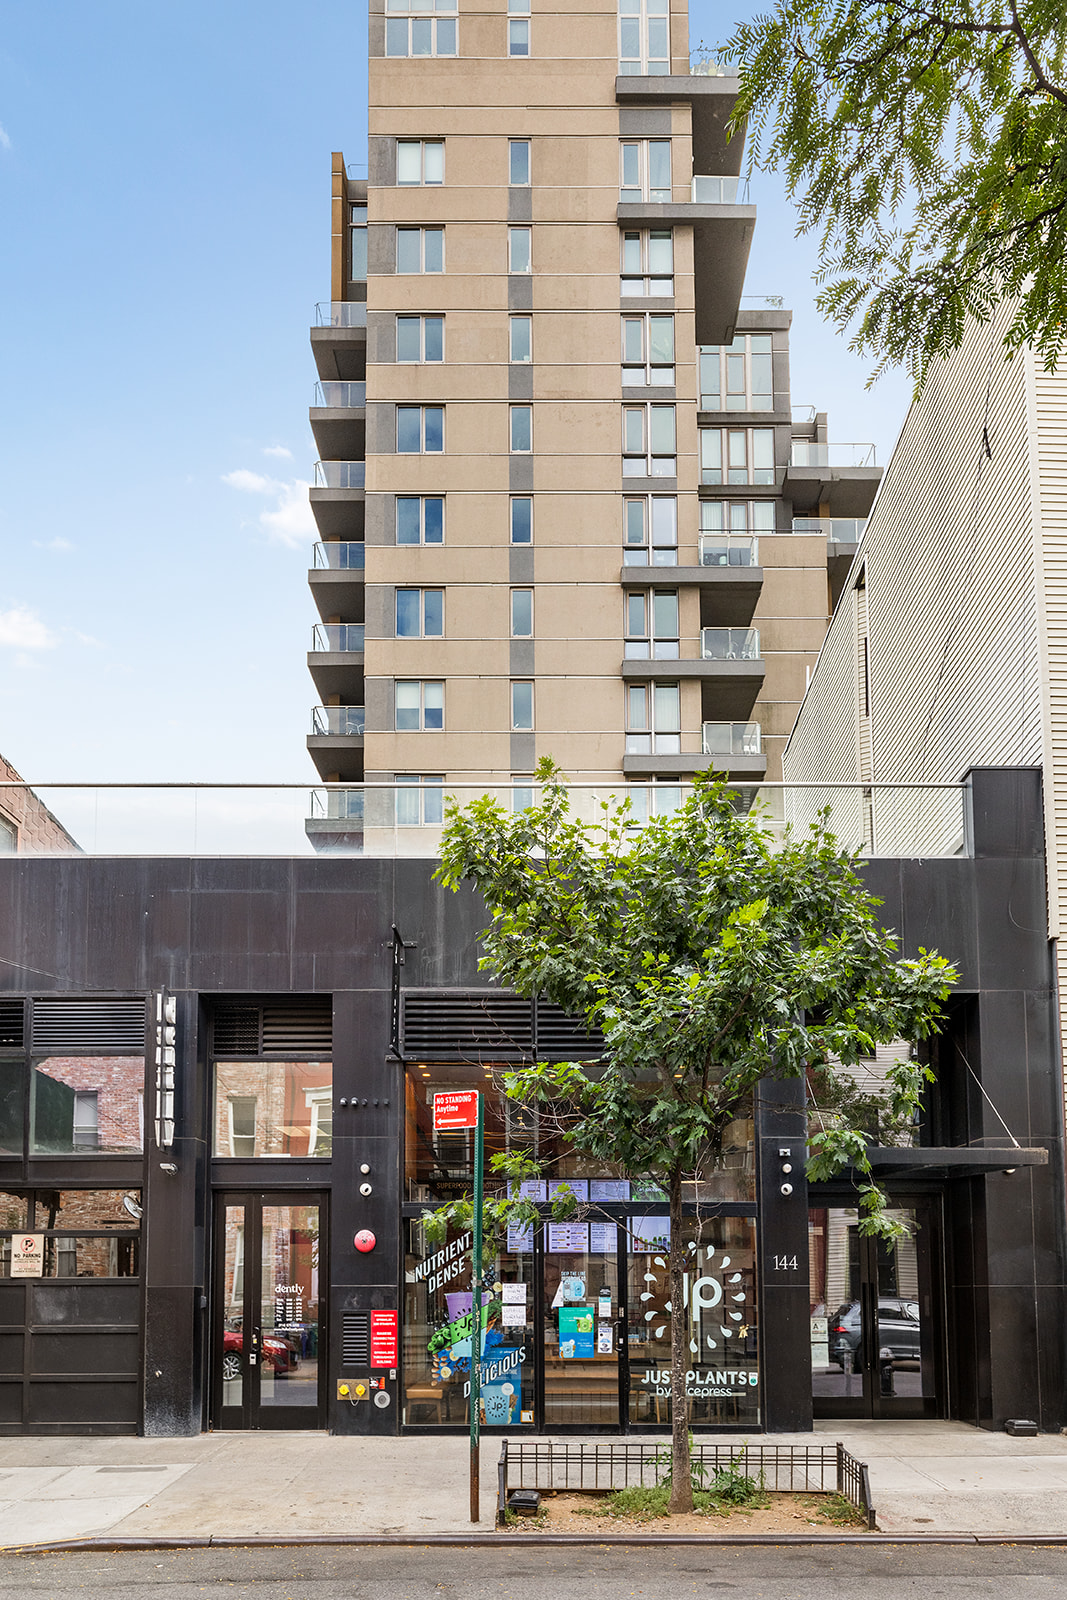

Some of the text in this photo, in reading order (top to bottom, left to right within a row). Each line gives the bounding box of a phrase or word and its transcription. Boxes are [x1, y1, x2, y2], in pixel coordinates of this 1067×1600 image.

[445, 1095, 472, 1103] STANDING
[436, 1105, 459, 1114] Anytime
[415, 1231, 471, 1283] NUTRIENT
[772, 1255, 799, 1271] 144
[428, 1256, 466, 1294] DENSE
[275, 1283, 304, 1295] dently
[463, 1346, 526, 1398] DLICIOUS
[641, 1370, 673, 1384] JUS
[685, 1370, 748, 1385] PLANTS
[656, 1384, 733, 1398] by icepress
